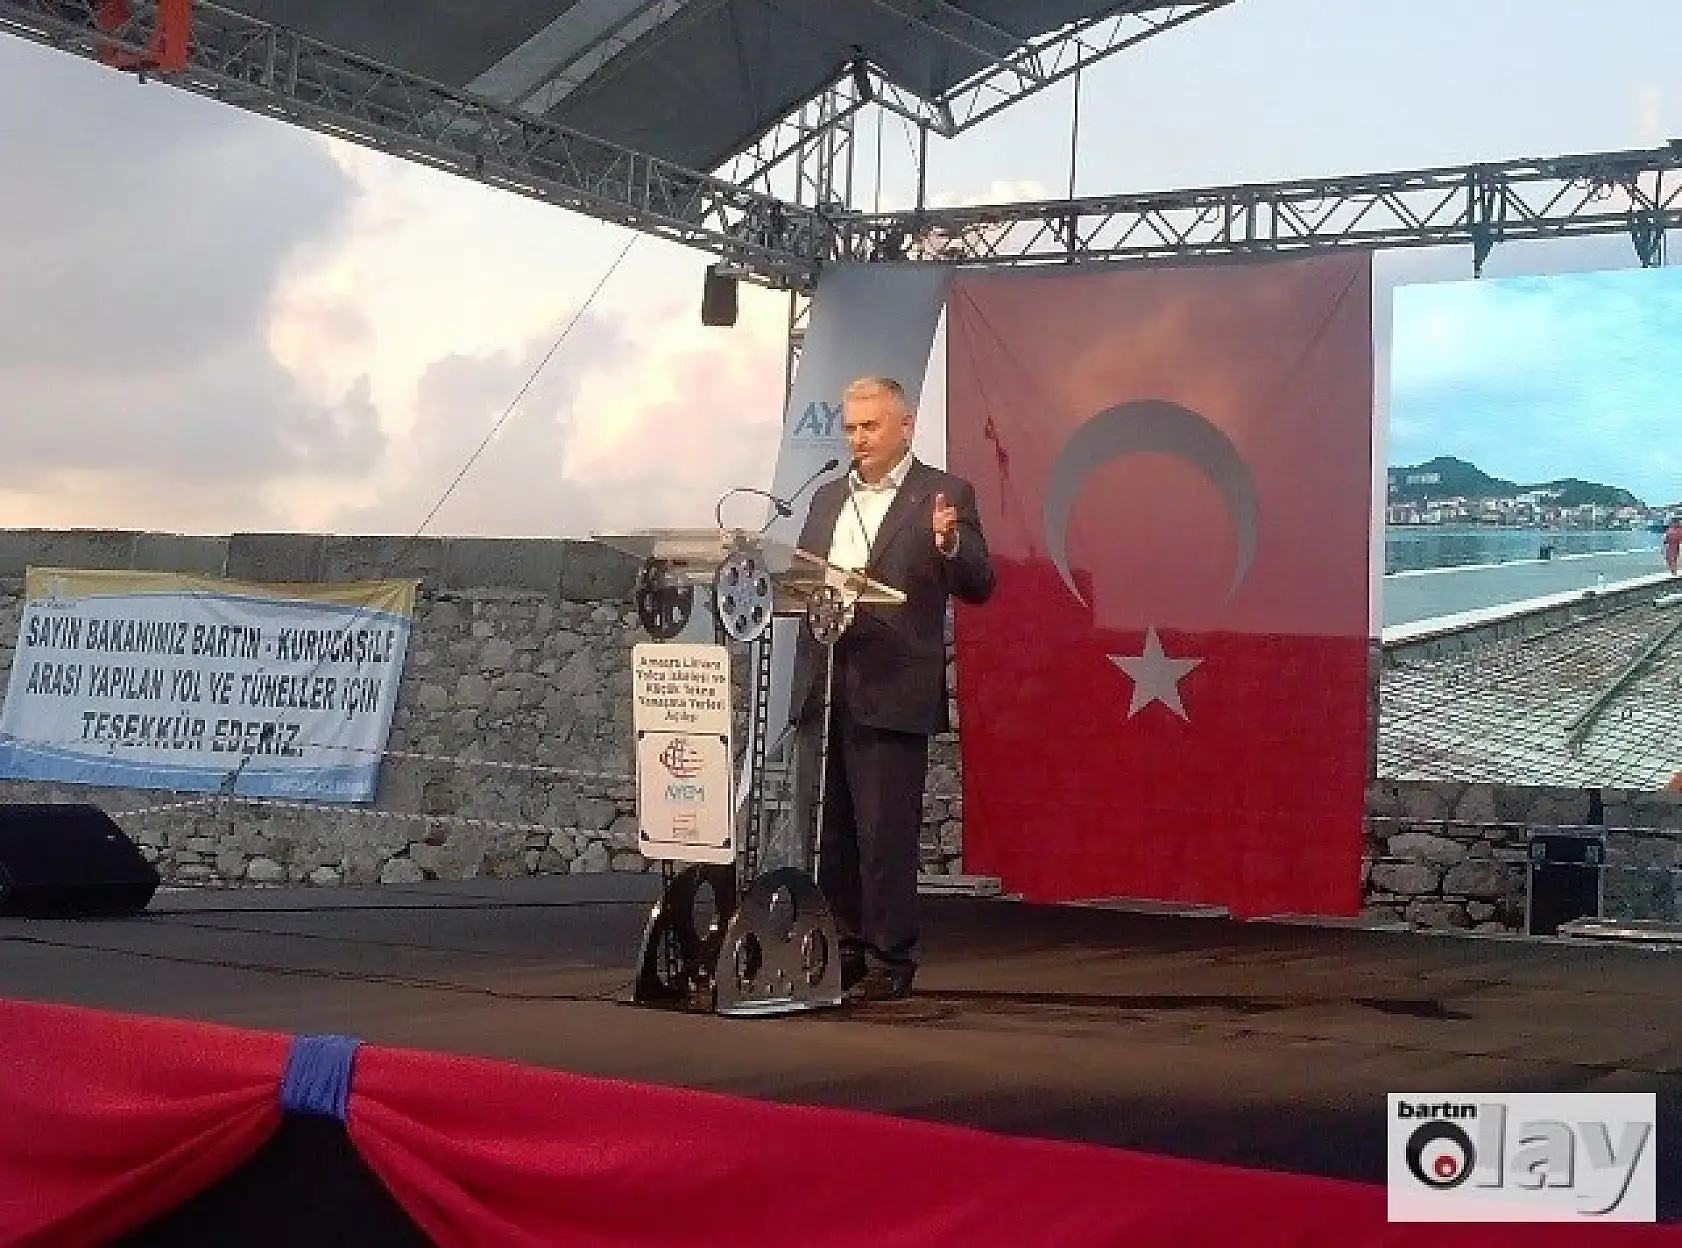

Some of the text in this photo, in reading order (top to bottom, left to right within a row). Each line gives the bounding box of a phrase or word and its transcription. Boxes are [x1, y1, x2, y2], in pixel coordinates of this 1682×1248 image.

[26, 615, 82, 650] SAYIN
[86, 618, 186, 655] BAKANIMIZ
[192, 622, 261, 660] BARTIN
[26, 661, 382, 720] ARASI YAPILAN YOL VE TÜNELLER İÇİN
[81, 709, 205, 754] TEŞEKKÜR
